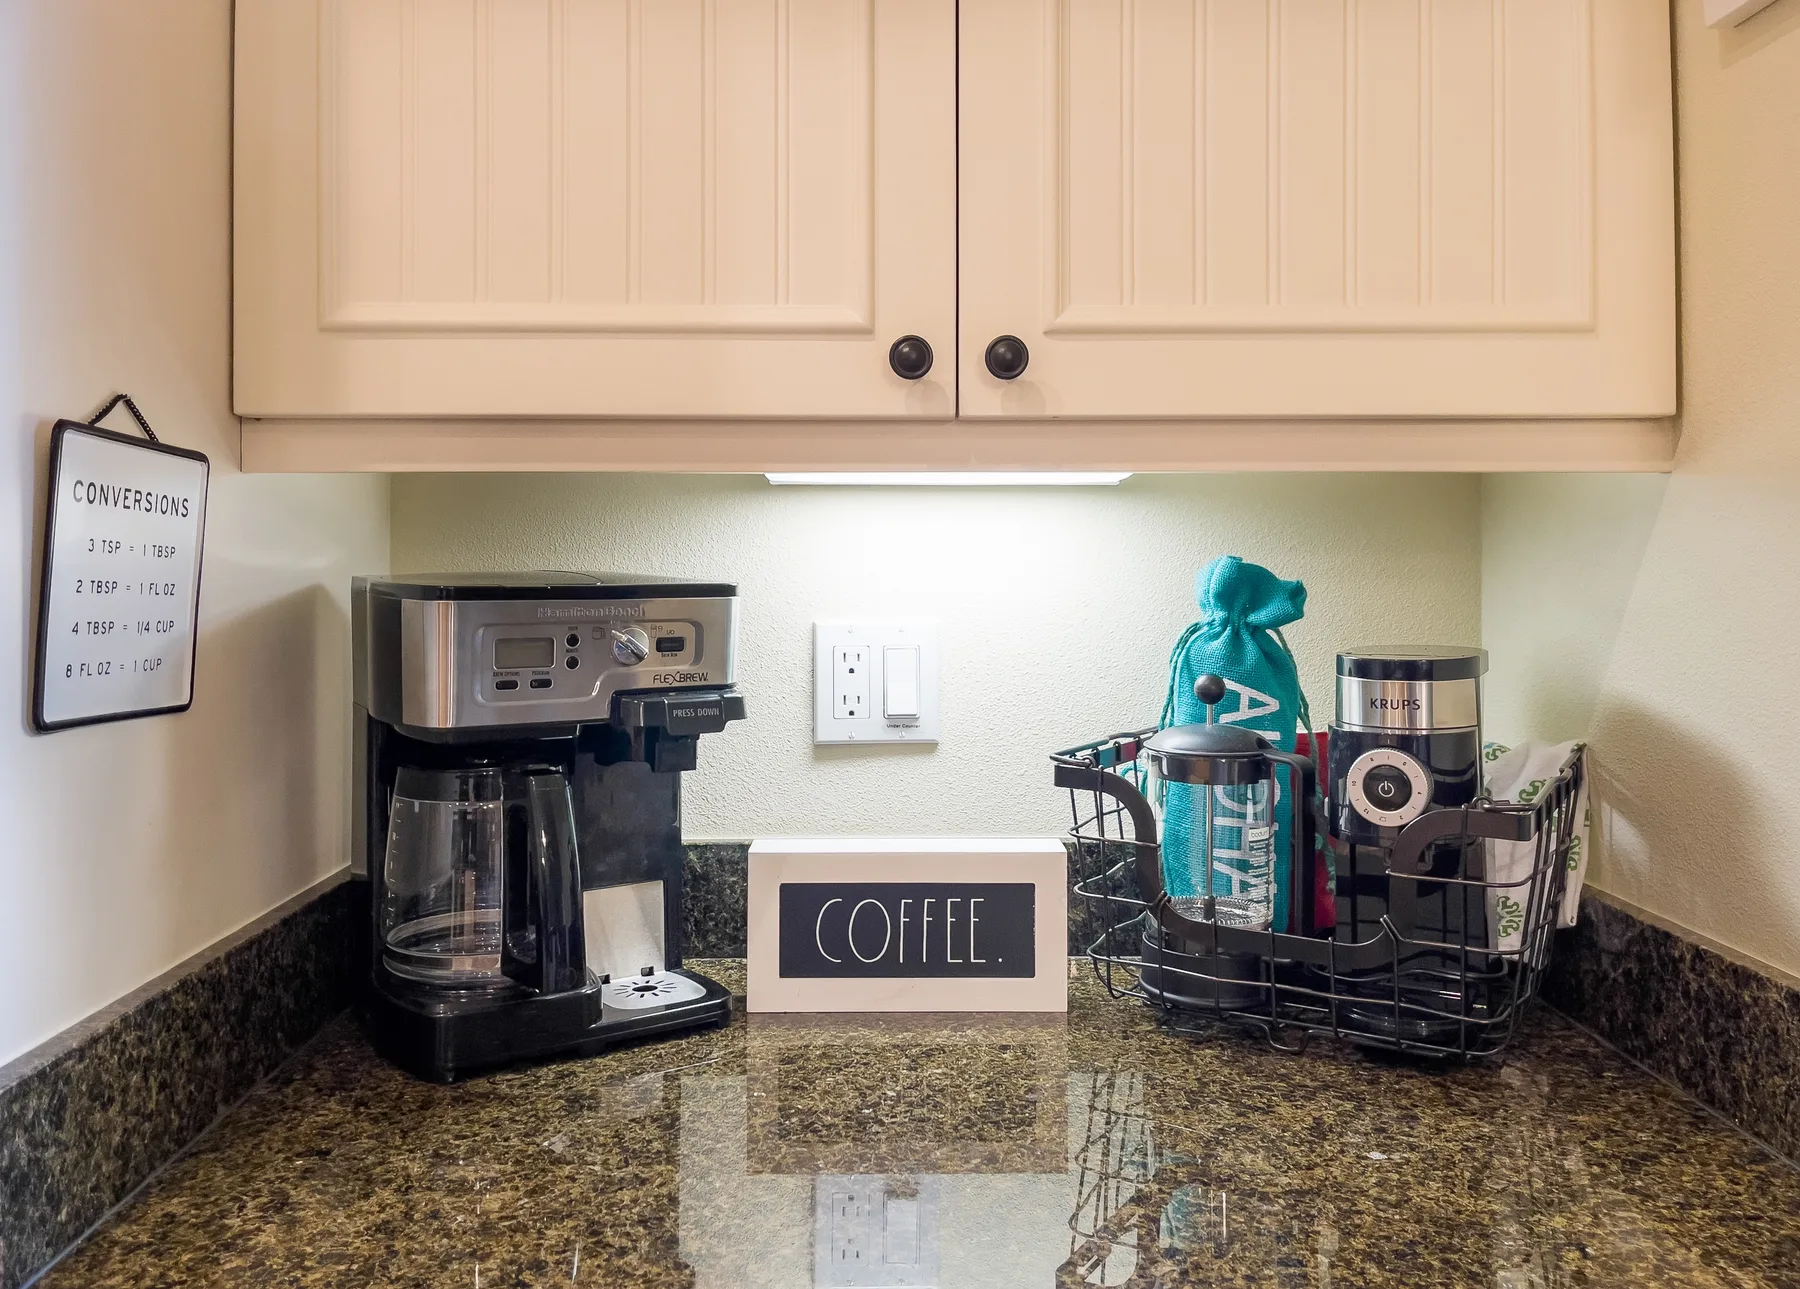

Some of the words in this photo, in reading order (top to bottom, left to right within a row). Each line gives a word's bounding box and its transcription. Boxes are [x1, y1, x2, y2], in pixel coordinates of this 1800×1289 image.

[73, 479, 190, 519] CONVERSIONS
[88, 538, 95, 553] 3
[101, 539, 121, 554] TSP
[152, 544, 176, 560] TBSP
[75, 579, 83, 594] 2
[90, 580, 118, 596] TBSP
[149, 582, 161, 597] FL
[163, 583, 176, 597] OZ
[537, 606, 604, 618] Hamilton
[72, 621, 79, 636] 4
[86, 621, 115, 637] TBSP
[136, 621, 150, 637] 1/4
[156, 620, 175, 635] CUP
[65, 663, 72, 679] 8
[80, 662, 93, 678] FL
[97, 661, 111, 677] OZ
[142, 658, 162, 673] CUP
[673, 708, 695, 717] PRESS
[697, 707, 720, 716] DOWN
[1370, 697, 1421, 711] KRUPS
[1213, 677, 1281, 905] AOHA
